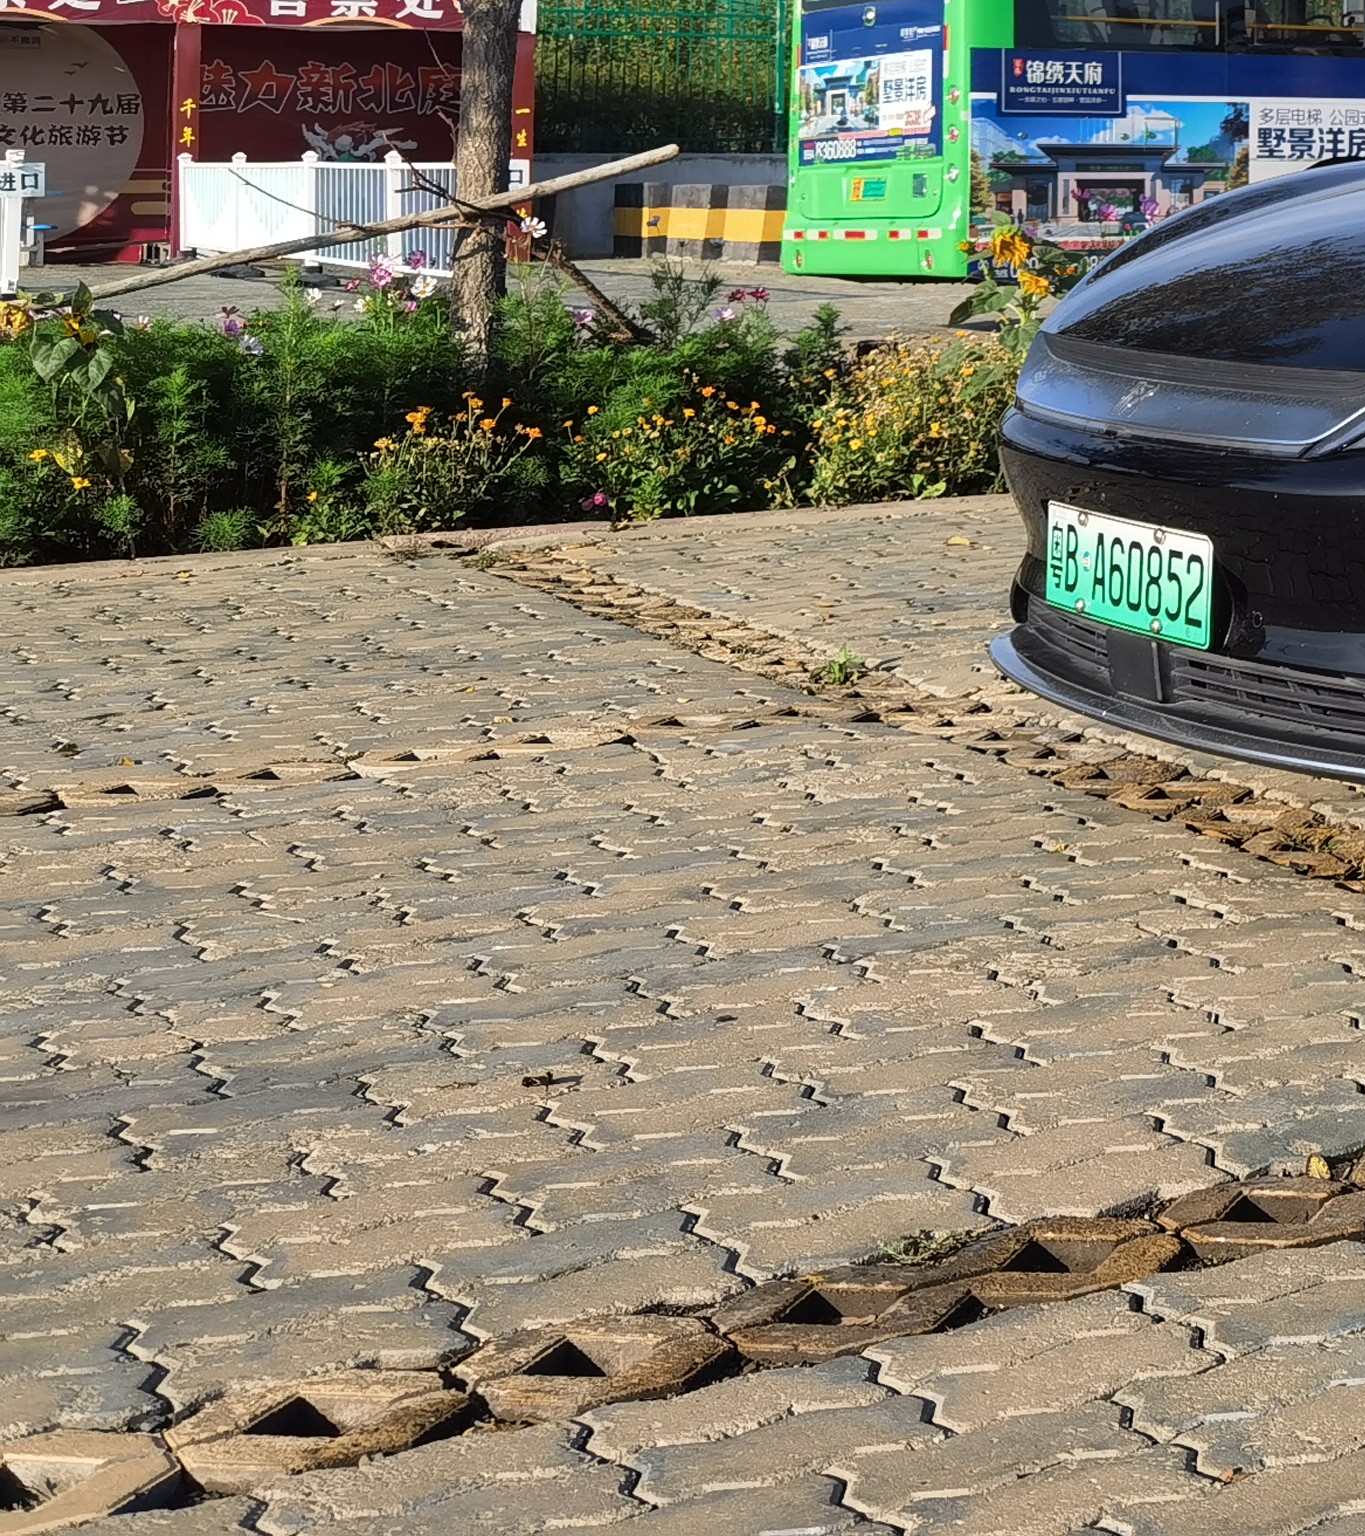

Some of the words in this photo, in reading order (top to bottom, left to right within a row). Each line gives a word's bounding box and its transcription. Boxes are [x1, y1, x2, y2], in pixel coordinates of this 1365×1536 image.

[1025, 60, 1104, 85] 锦绣天府
[3, 92, 142, 116] 第二十九届
[1259, 107, 1323, 126] 多层电梯
[0, 124, 130, 147] 文化旅游节
[0, 172, 39, 192] 进口
